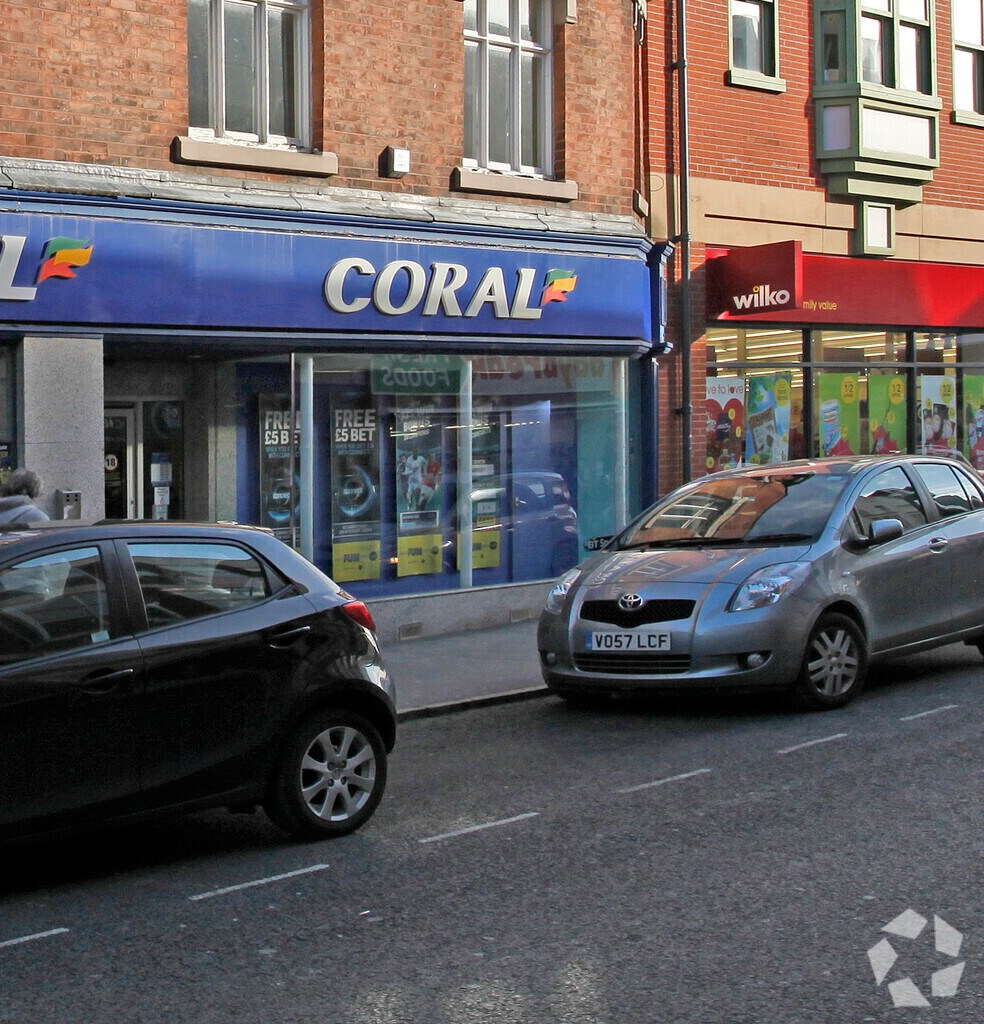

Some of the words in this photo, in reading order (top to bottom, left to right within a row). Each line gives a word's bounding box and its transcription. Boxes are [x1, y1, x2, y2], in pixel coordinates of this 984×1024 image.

[325, 257, 543, 320] CORAL
[733, 285, 790, 310] wilko
[803, 301, 817, 311] mily
[819, 301, 837, 310] value
[718, 384, 726, 394] to
[844, 383, 854, 393] 1/2
[892, 383, 901, 393] 1/2
[335, 409, 376, 428] FREE
[264, 430, 278, 445] £5
[335, 428, 348, 442] £5
[350, 427, 376, 441] BET
[106, 458, 115, 467] 18
[596, 634, 632, 649] VO57
[638, 634, 667, 649] LCF
